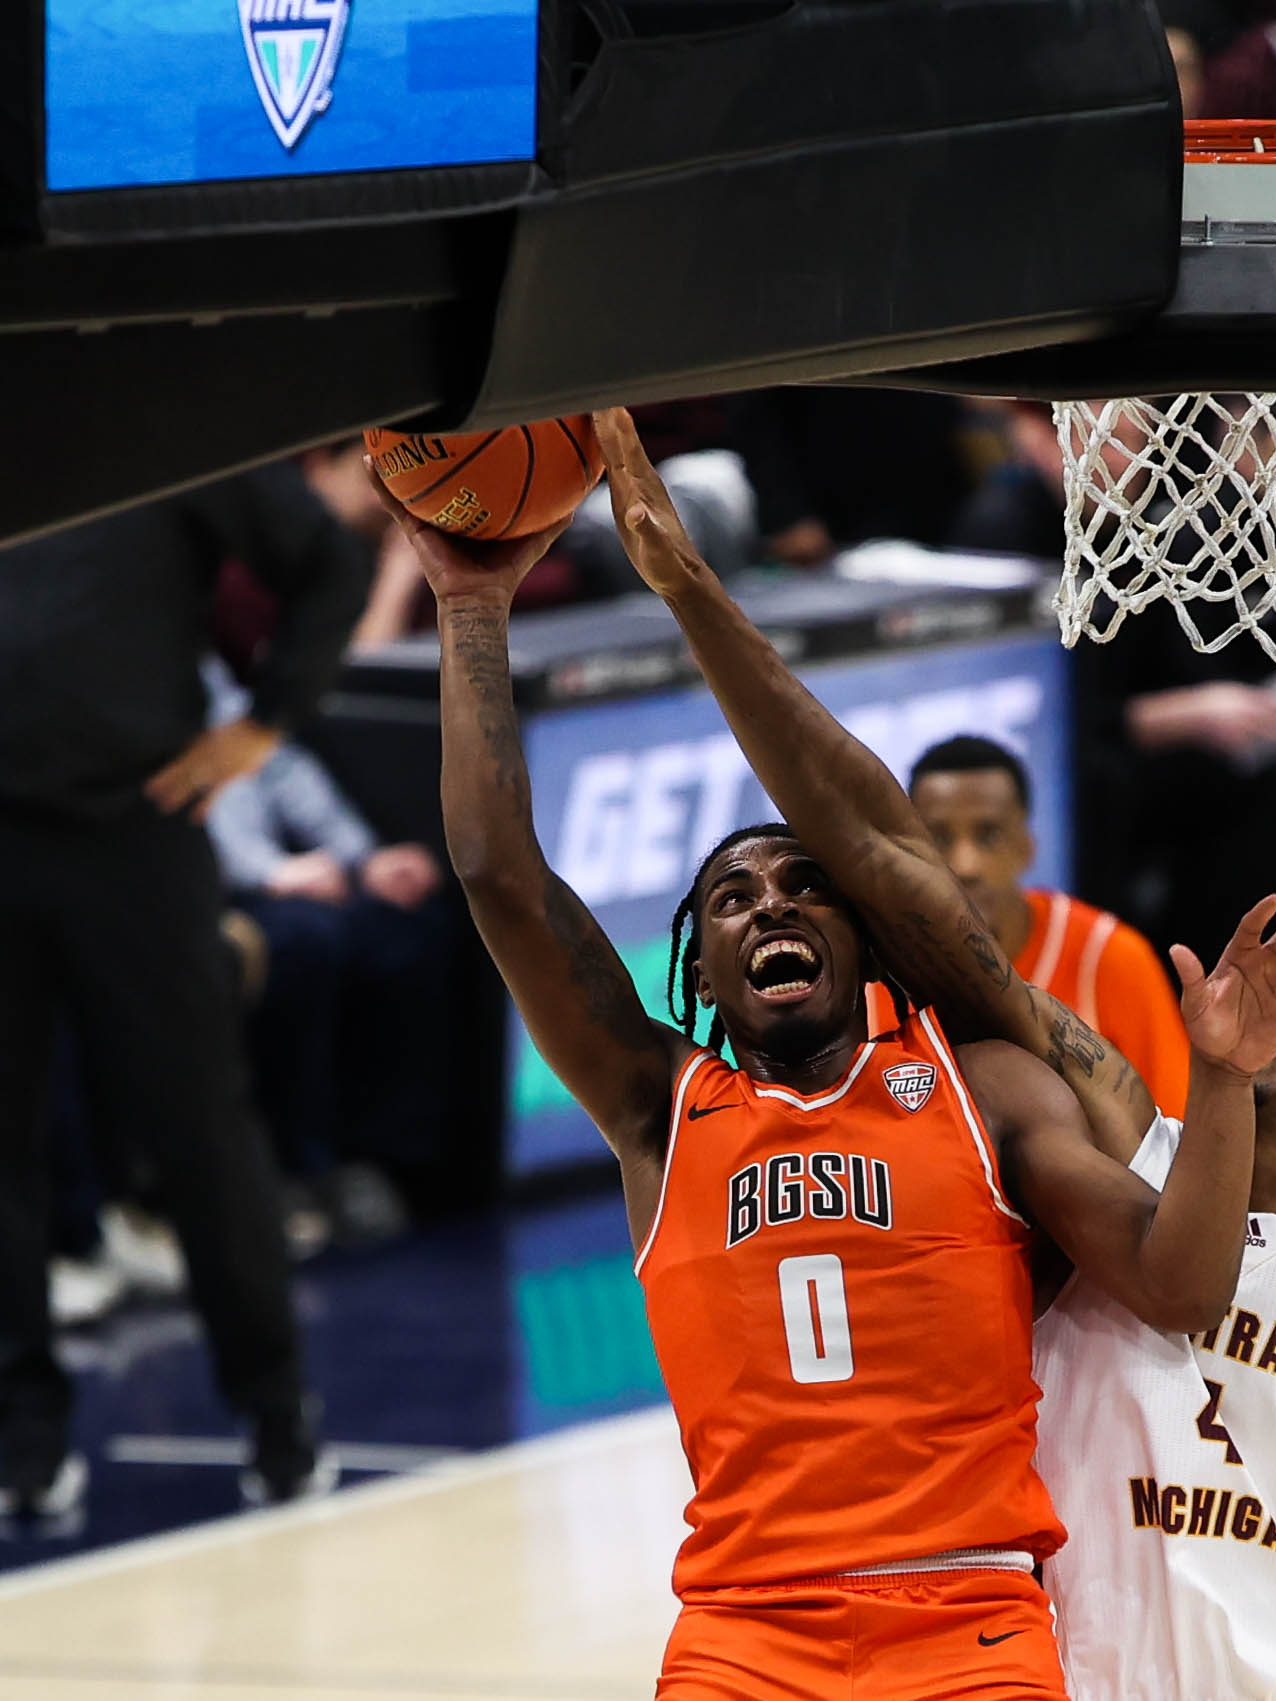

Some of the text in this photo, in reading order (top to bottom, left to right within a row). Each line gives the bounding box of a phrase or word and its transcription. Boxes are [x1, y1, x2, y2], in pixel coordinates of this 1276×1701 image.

[889, 1077, 934, 1093] MAC
[726, 1152, 893, 1249] BGSU
[778, 1254, 854, 1383] 0
